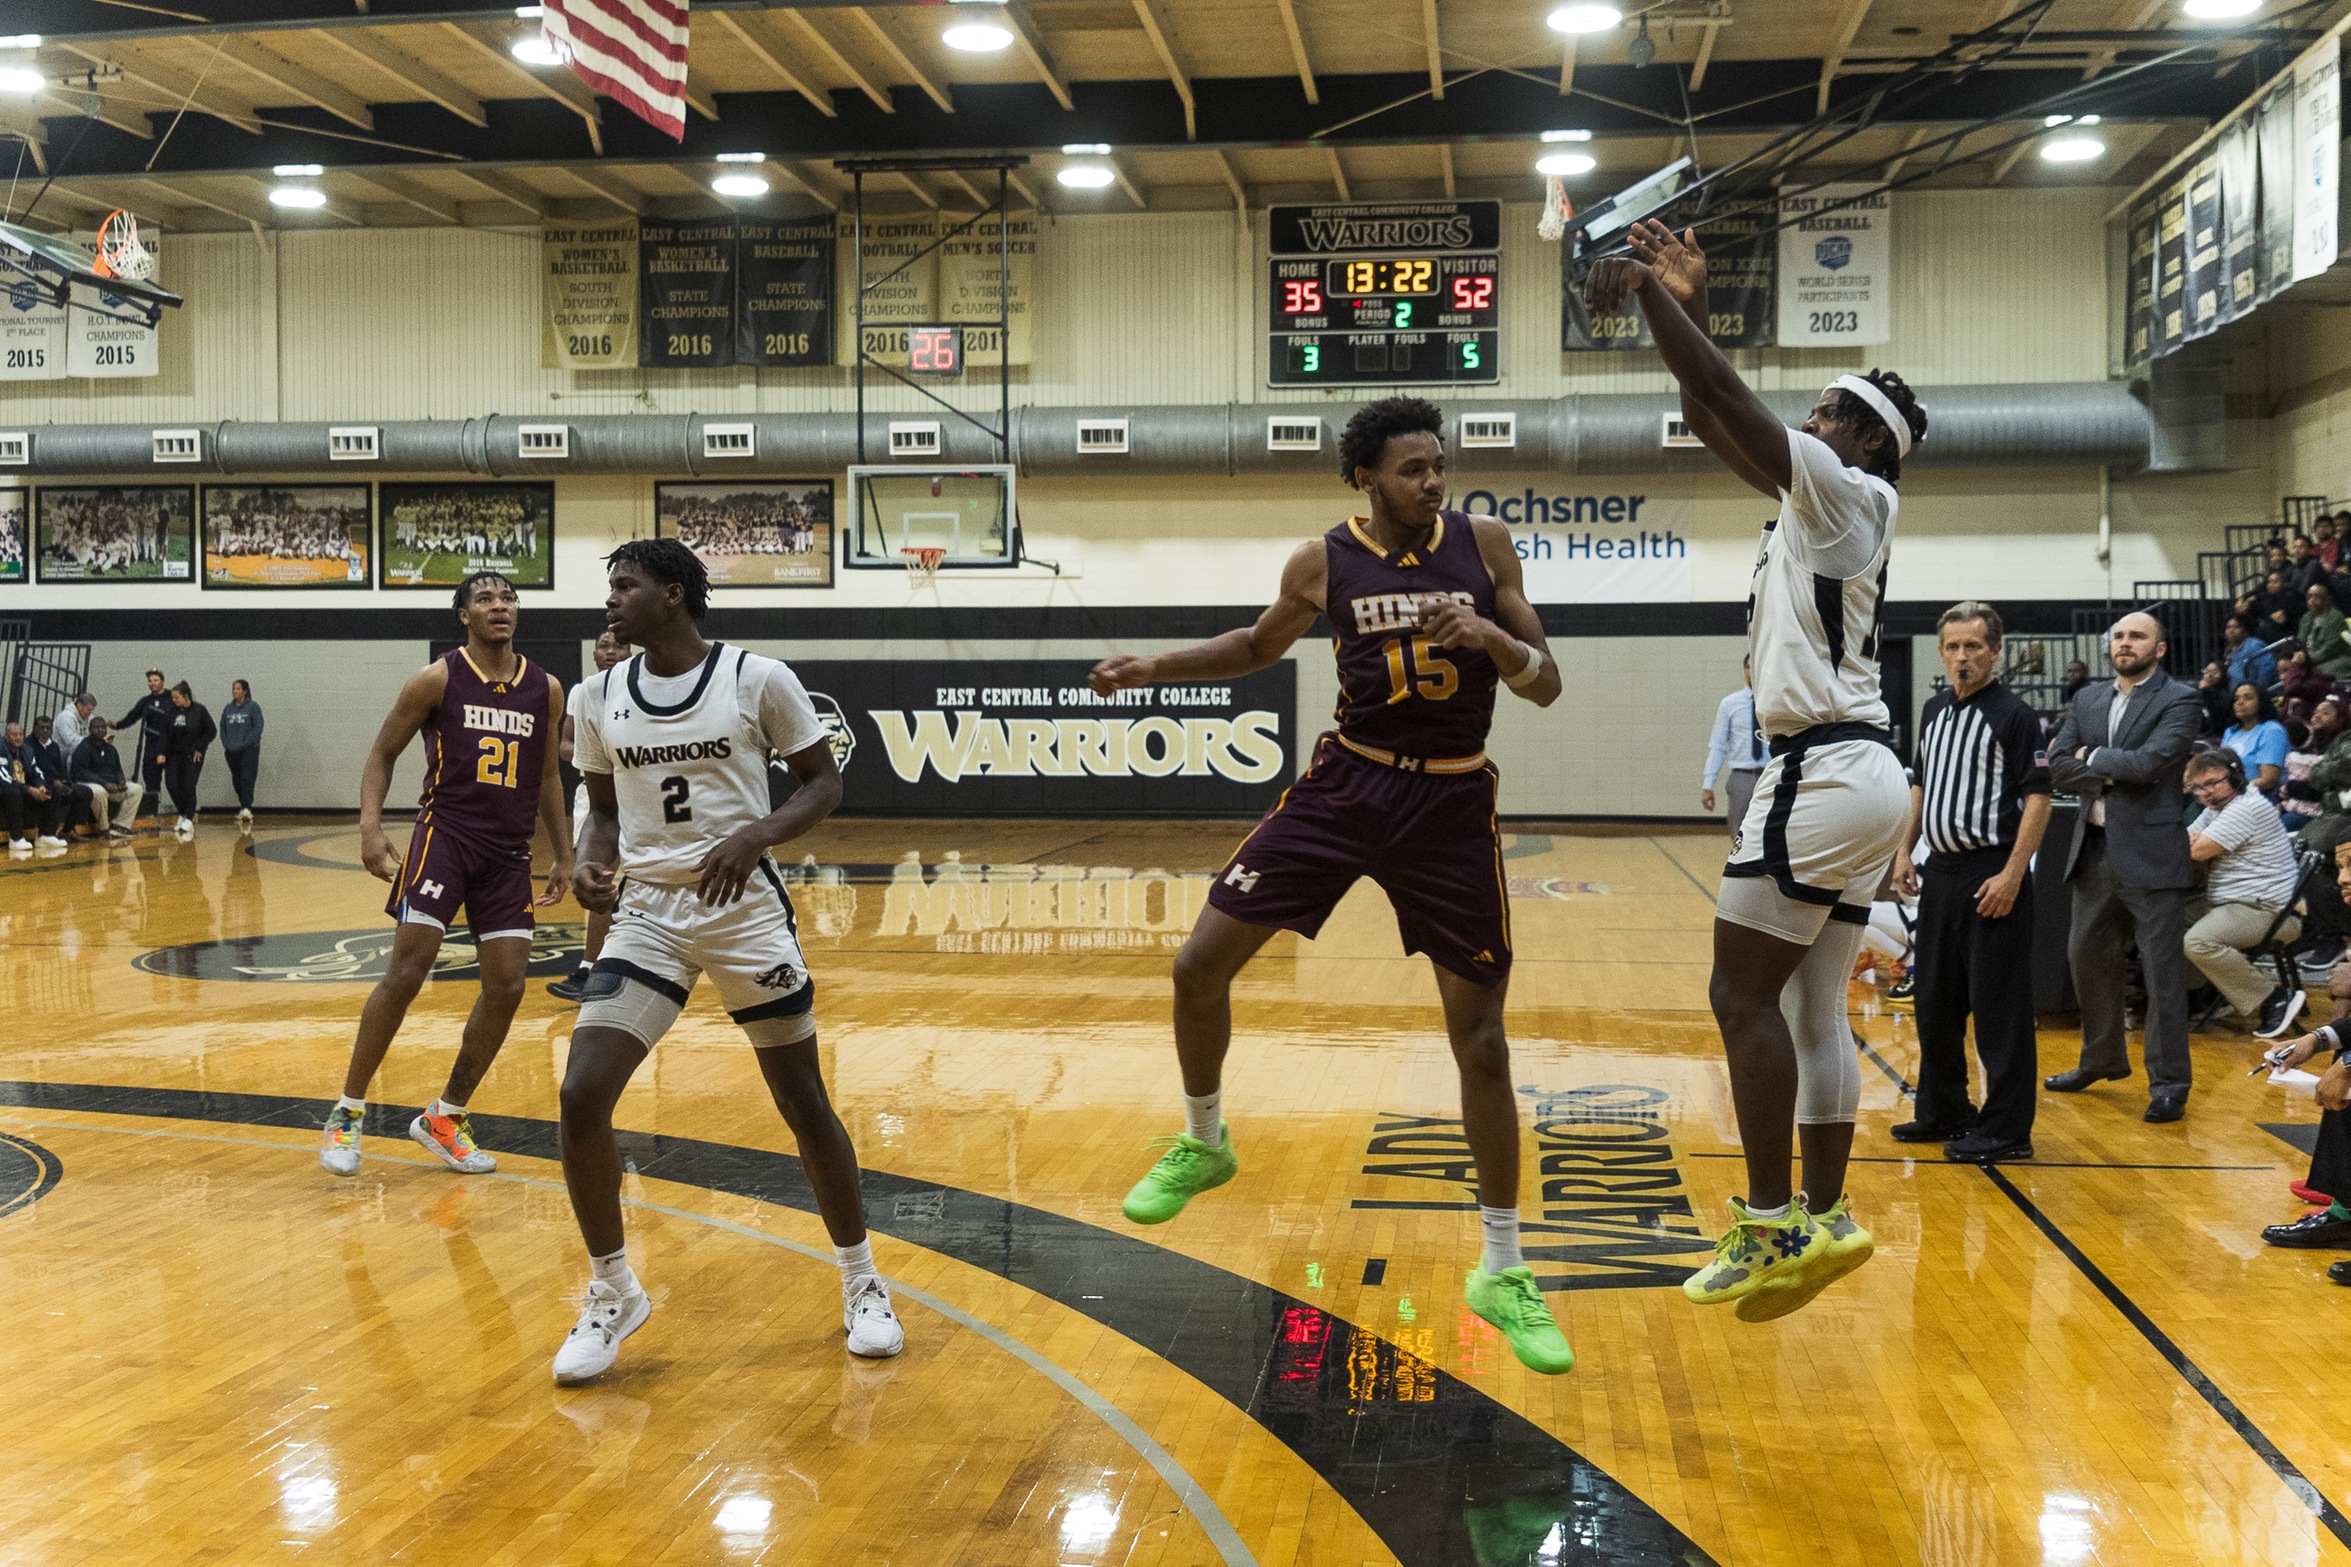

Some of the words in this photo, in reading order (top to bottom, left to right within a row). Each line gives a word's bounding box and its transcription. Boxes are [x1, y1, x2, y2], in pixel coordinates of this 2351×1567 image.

[1783, 198, 1817, 212] EAST
[840, 225, 872, 238] EAT
[877, 224, 936, 238] CENTRAL
[1799, 217, 1872, 232] BASEBALL
[545, 229, 576, 242] EAST
[581, 228, 637, 241] CENTRAL
[642, 228, 674, 240] EAST
[679, 226, 735, 240] CENTRAL
[741, 226, 773, 239] EAST
[778, 226, 834, 240] CENTRAL
[1297, 215, 1473, 251] WARRIORS
[562, 247, 620, 261] WOMEN'S
[658, 246, 717, 259] WOMEN'S
[755, 245, 819, 258] BASEBALL
[859, 244, 920, 257] OOTBALL
[943, 242, 982, 256] MEN'S
[551, 261, 630, 275] BASKETBALL
[649, 259, 730, 273] BASKETBALL
[1279, 263, 1319, 278] HOME
[1443, 259, 1497, 274] VISITOR
[1347, 261, 1432, 293] 13:22
[1798, 276, 1834, 288] WORLD
[569, 282, 612, 293] SOUTH
[767, 283, 807, 295] STATE
[1454, 277, 1493, 309] 52
[563, 298, 619, 309] DIVISION
[669, 290, 708, 302] STATE
[1284, 281, 1321, 312] 35
[651, 306, 729, 319] CHAMPIONS
[748, 299, 826, 311] CHAMPIONS
[553, 314, 630, 325] CHAMPIONS
[1295, 316, 1329, 328] BONUS
[1354, 309, 1391, 320] PERIOD
[1395, 301, 1412, 328] 2
[1438, 314, 1473, 326] BONUS
[1809, 311, 1858, 333] 2023
[19, 328, 46, 336] PLACE
[1591, 316, 1640, 338] 2023
[1709, 314, 1744, 336] 023
[87, 330, 145, 342] CHAMPIONS
[866, 333, 910, 353] 2016
[1288, 336, 1320, 347] FOULS
[1349, 335, 1386, 345] PLAYER
[1394, 334, 1426, 345] FOULS
[1447, 333, 1479, 344] FOULS
[569, 335, 612, 355] 2016
[668, 335, 712, 356] 2016
[765, 334, 810, 355] 2016
[911, 332, 955, 370] 26
[7, 349, 44, 368] 2015
[96, 345, 135, 365] 2015
[1302, 346, 1319, 372] 3
[1462, 342, 1480, 369] 5
[1462, 488, 1647, 524] Ochsner
[1515, 532, 1552, 560] sh
[1567, 531, 1686, 560] Health
[1382, 634, 1459, 705] 15
[936, 687, 976, 706] EAST
[981, 687, 1052, 706] CENTRAL
[1160, 687, 1232, 705] COLLEGE
[463, 703, 535, 737] HINDS
[615, 737, 732, 769] WARRIORS
[868, 710, 1285, 784] WARRIORS
[476, 736, 519, 788] 21
[661, 775, 692, 824] 2
[1223, 863, 1262, 893] H
[419, 879, 445, 900] H
[1517, 1084, 1721, 1292] WARRIORS
